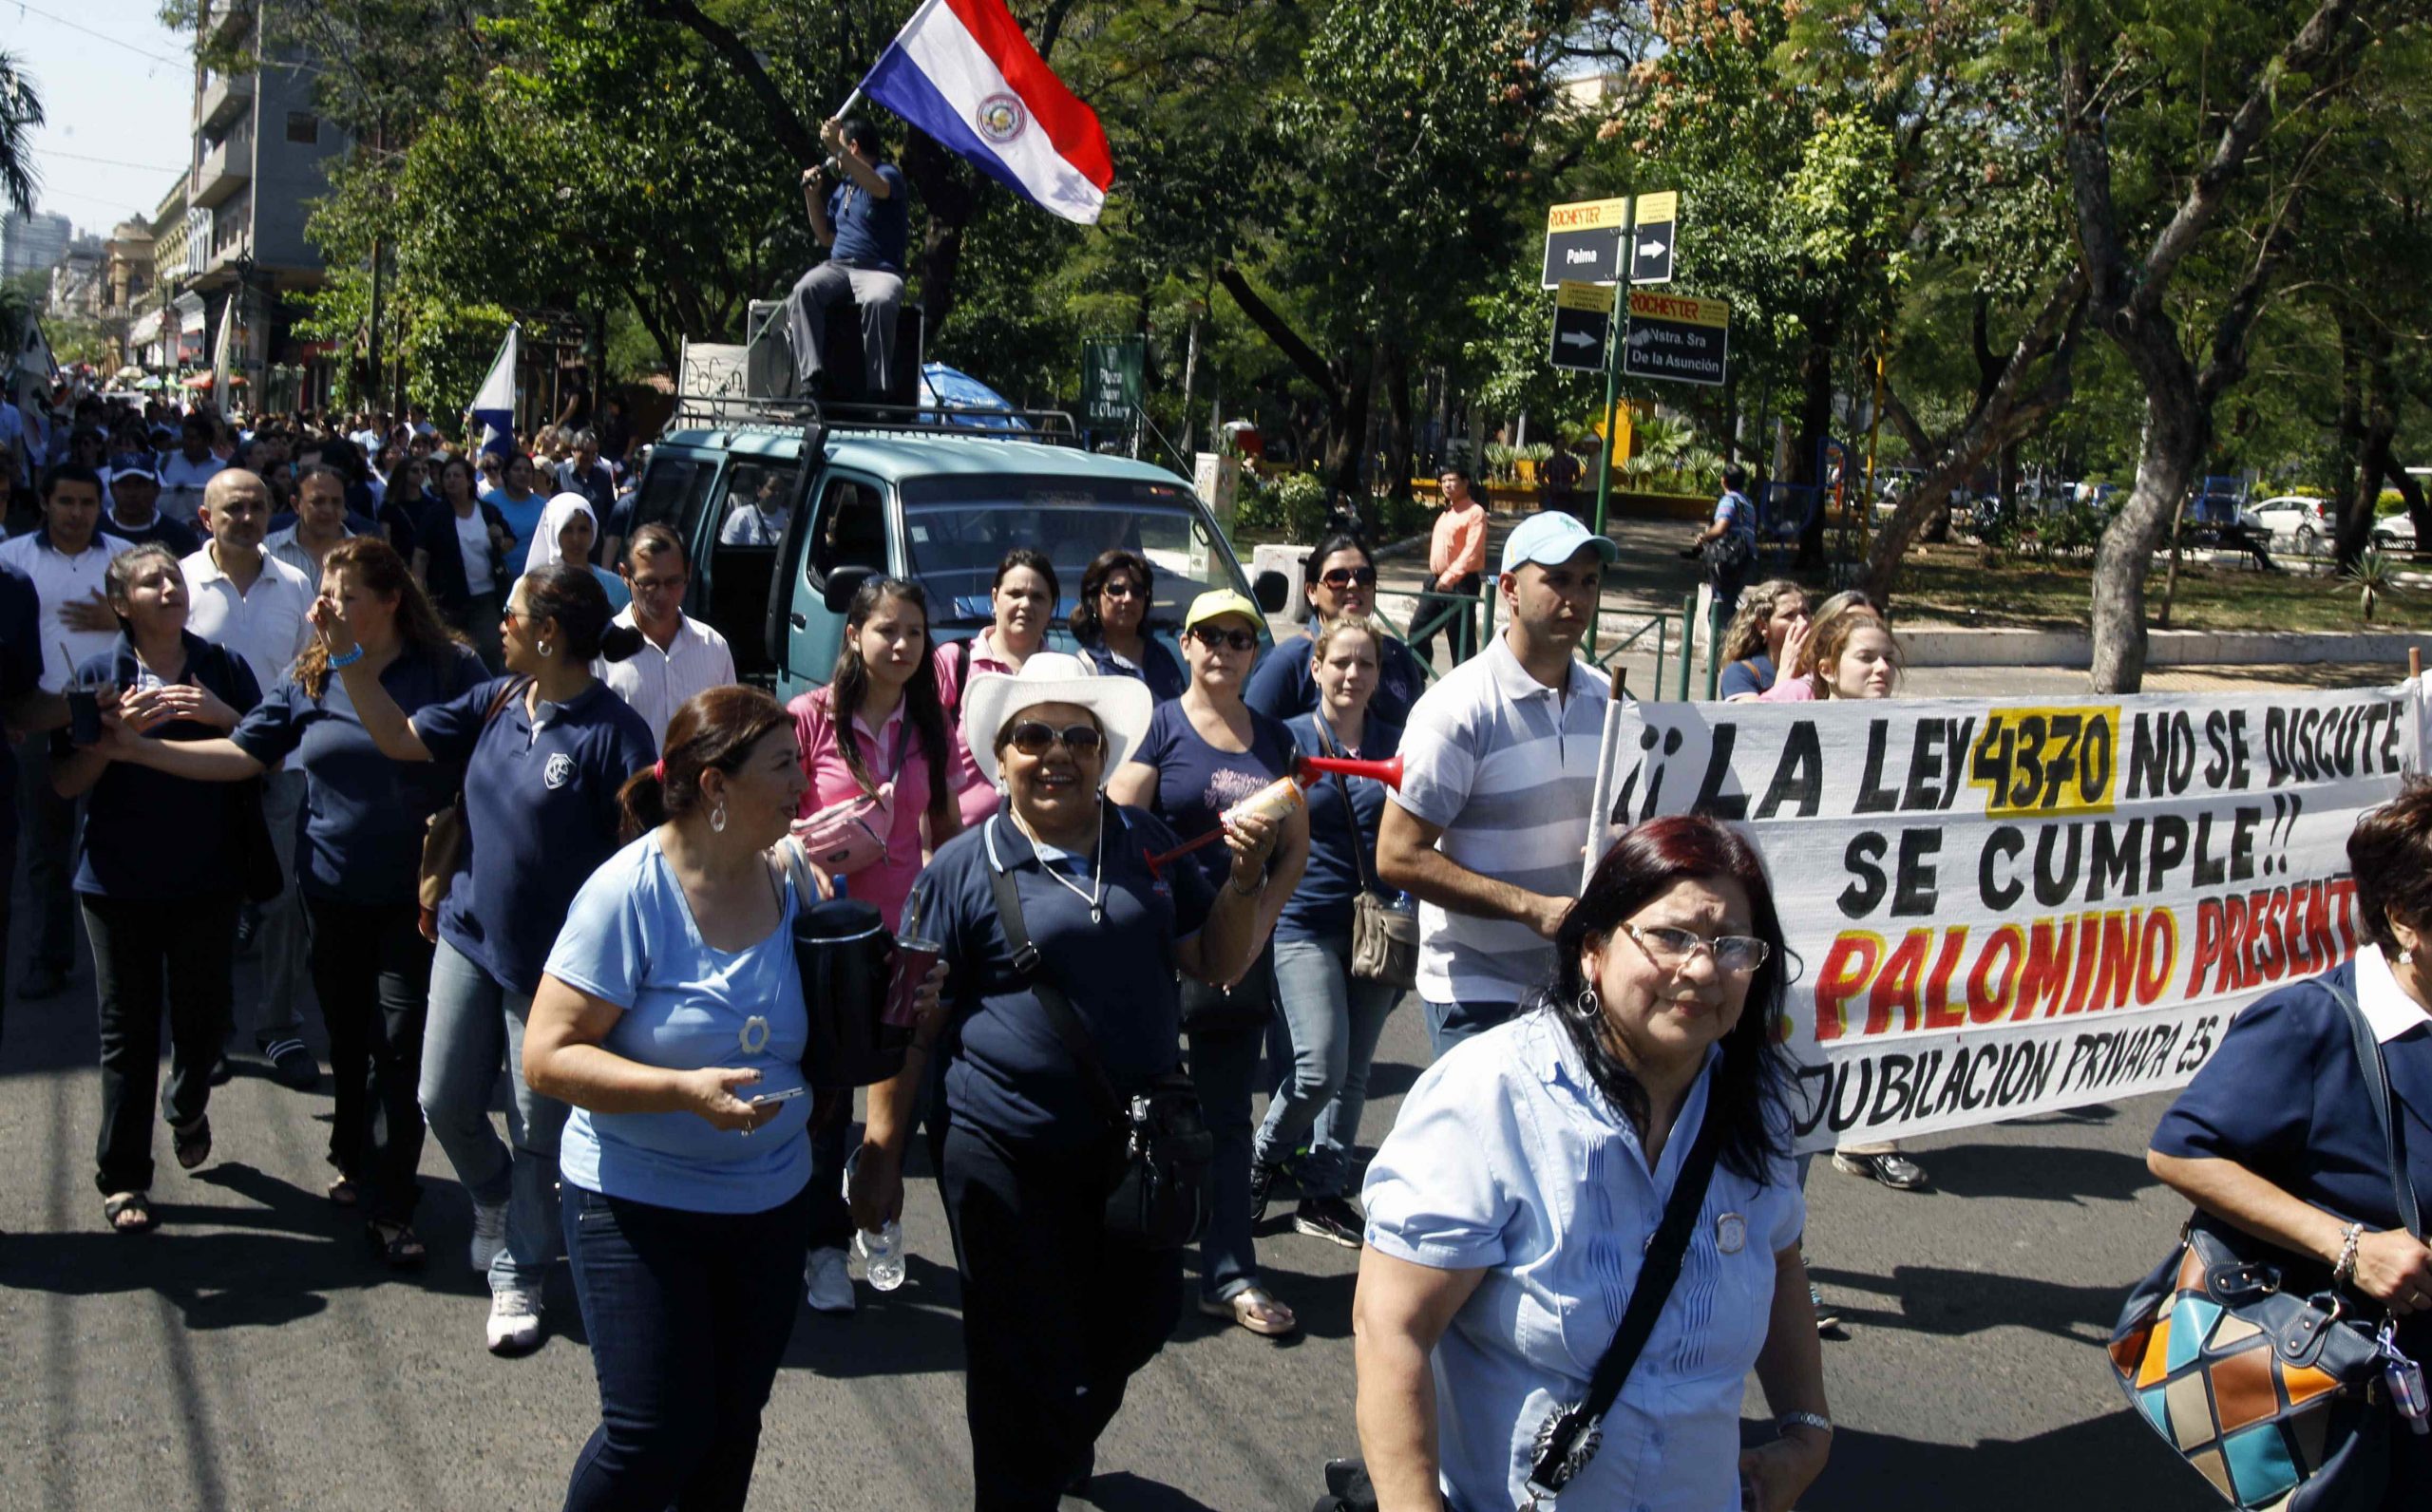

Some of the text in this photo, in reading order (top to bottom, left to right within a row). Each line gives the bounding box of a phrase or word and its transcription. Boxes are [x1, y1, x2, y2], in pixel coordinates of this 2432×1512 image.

[1550, 205, 1601, 227] ROCHESTER
[1567, 248, 1597, 265] Palma
[1630, 293, 1699, 321] ROCHESTER
[1651, 328, 1706, 349] Nstra. Sra
[1632, 350, 1720, 373] De la Asunción
[1099, 368, 1122, 385] Plaza
[1100, 385, 1121, 401] Juan
[1099, 401, 1130, 425] O'Leary
[1852, 716, 1976, 814] LEY
[1973, 714, 2111, 809] 4370
[2125, 709, 2195, 800] NO
[2204, 709, 2251, 790] SE
[2266, 700, 2404, 787] DISCUTE
[1836, 793, 2303, 919] SE CUMPLE!!
[1815, 871, 2358, 1042] PALOMINO PRESENT
[1793, 1014, 2219, 1137] JUBILACION PRIVADA ES
